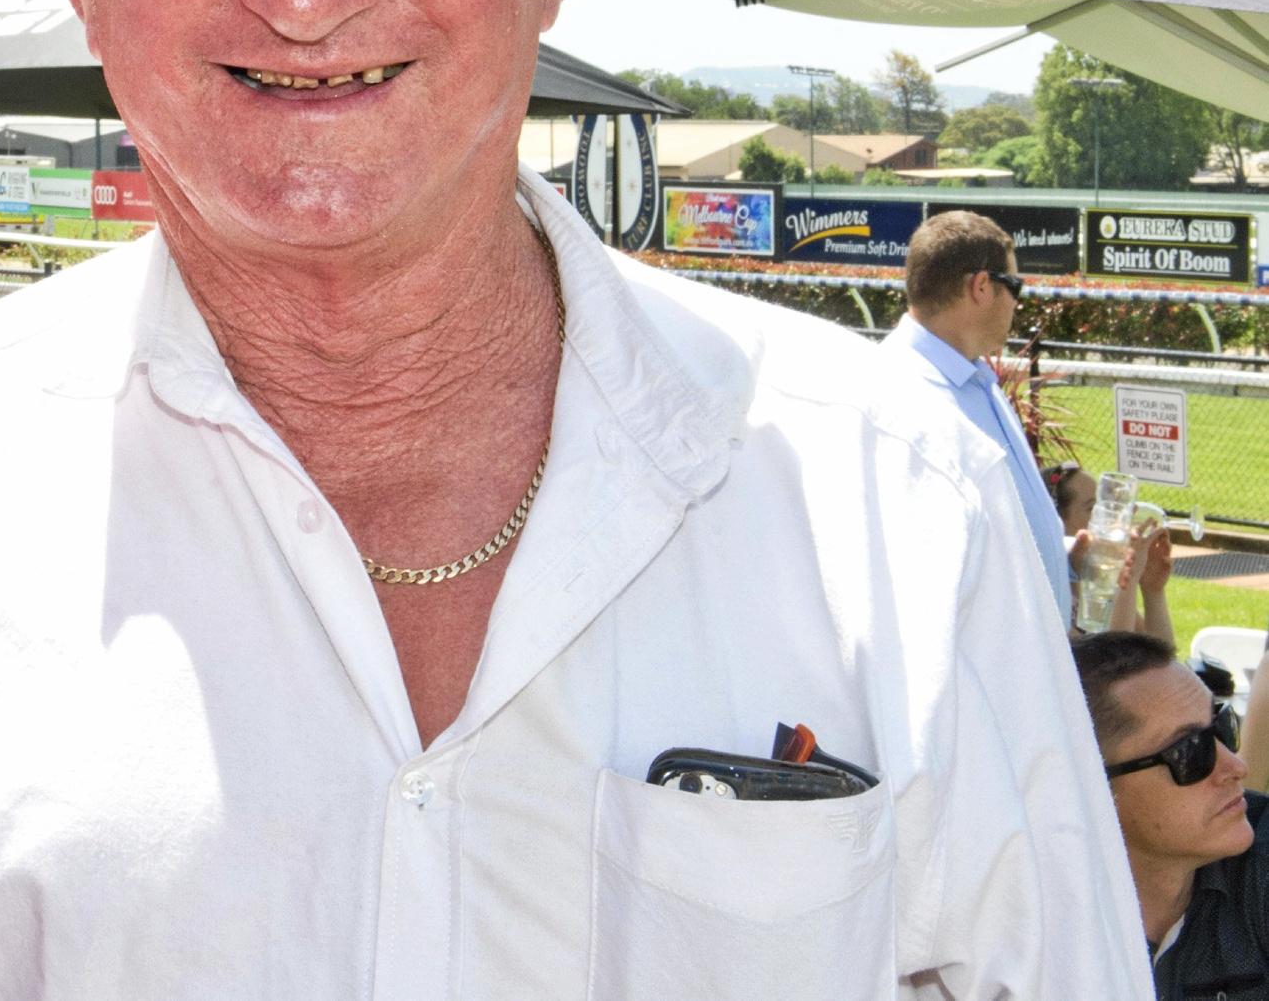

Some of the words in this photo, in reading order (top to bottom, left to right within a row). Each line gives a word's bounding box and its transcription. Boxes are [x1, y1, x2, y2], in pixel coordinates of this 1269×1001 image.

[678, 203, 733, 227] Melbourne
[734, 204, 758, 235] Cup
[785, 207, 869, 240] Wimmers
[1119, 216, 1187, 241] EUREKA
[1188, 219, 1236, 244] STUD
[824, 238, 866, 255] Premium
[867, 240, 888, 258] Soft
[889, 241, 911, 257] Drin
[1103, 245, 1152, 273] Spirit
[1154, 247, 1179, 271] Of
[1180, 249, 1231, 273] Boom
[1122, 399, 1137, 407] FOR
[1139, 400, 1158, 409] YOUR
[1160, 401, 1178, 411] OWN
[1122, 408, 1149, 418] SAFETY
[1151, 410, 1178, 421] PLEASE
[1129, 422, 1147, 435] DO
[1148, 424, 1172, 438] NOT
[1126, 439, 1147, 449] CLIMB
[1149, 441, 1161, 450] ON
[1163, 443, 1175, 452] THE
[1127, 449, 1149, 459] FENCE
[1152, 452, 1163, 460] OR
[1165, 454, 1175, 462] SIT
[1128, 460, 1140, 469] ON
[1142, 461, 1156, 471] THE
